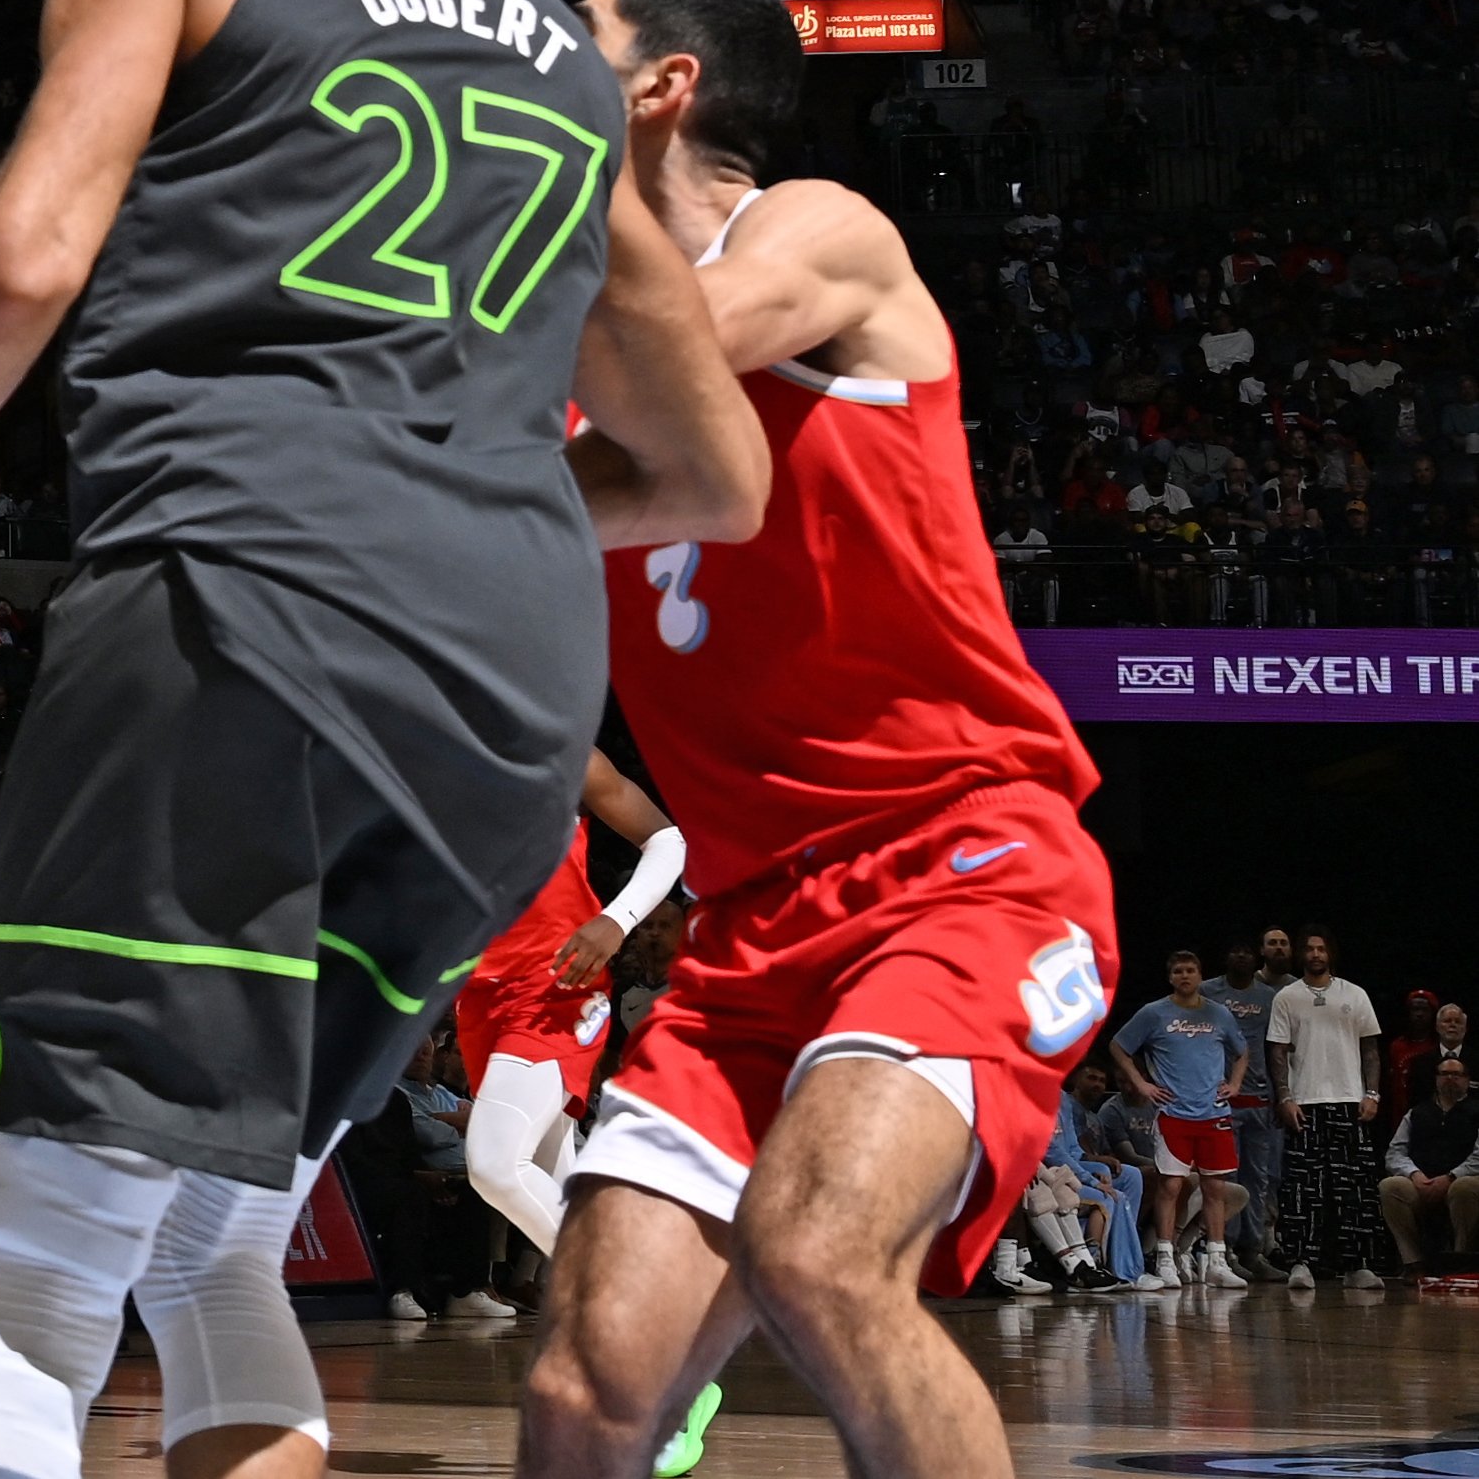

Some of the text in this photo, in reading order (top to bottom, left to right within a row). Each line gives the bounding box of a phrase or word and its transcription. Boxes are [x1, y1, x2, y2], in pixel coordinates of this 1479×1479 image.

[825, 23, 936, 38] Plaza Level 103 & 116
[934, 63, 975, 84] 102
[279, 58, 609, 334] 27
[1117, 663, 1195, 688] NEXEN
[1213, 656, 1393, 695] NEXEN
